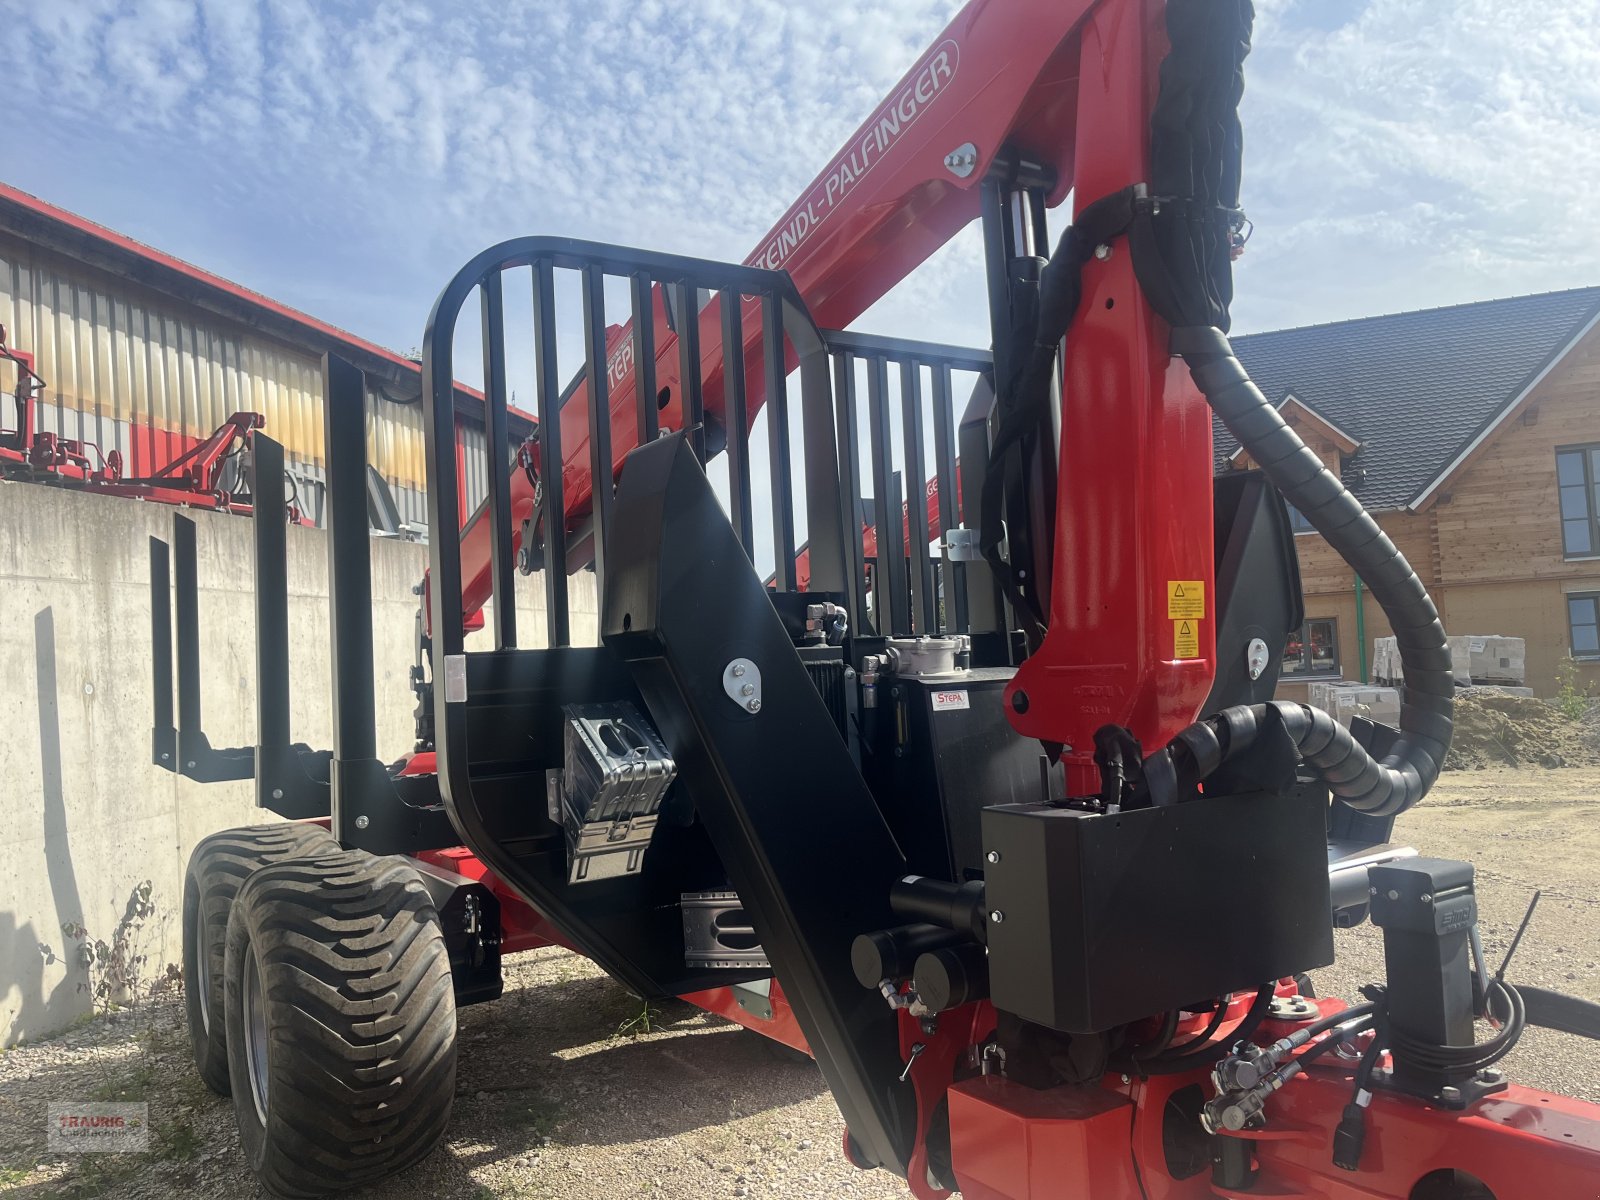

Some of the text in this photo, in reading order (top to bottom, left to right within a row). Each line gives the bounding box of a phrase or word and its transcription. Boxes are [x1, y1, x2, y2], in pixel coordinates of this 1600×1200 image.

[752, 50, 951, 271] TEINDL-PALFINGER
[607, 339, 634, 390] TEP
[937, 692, 963, 703] STEPA
